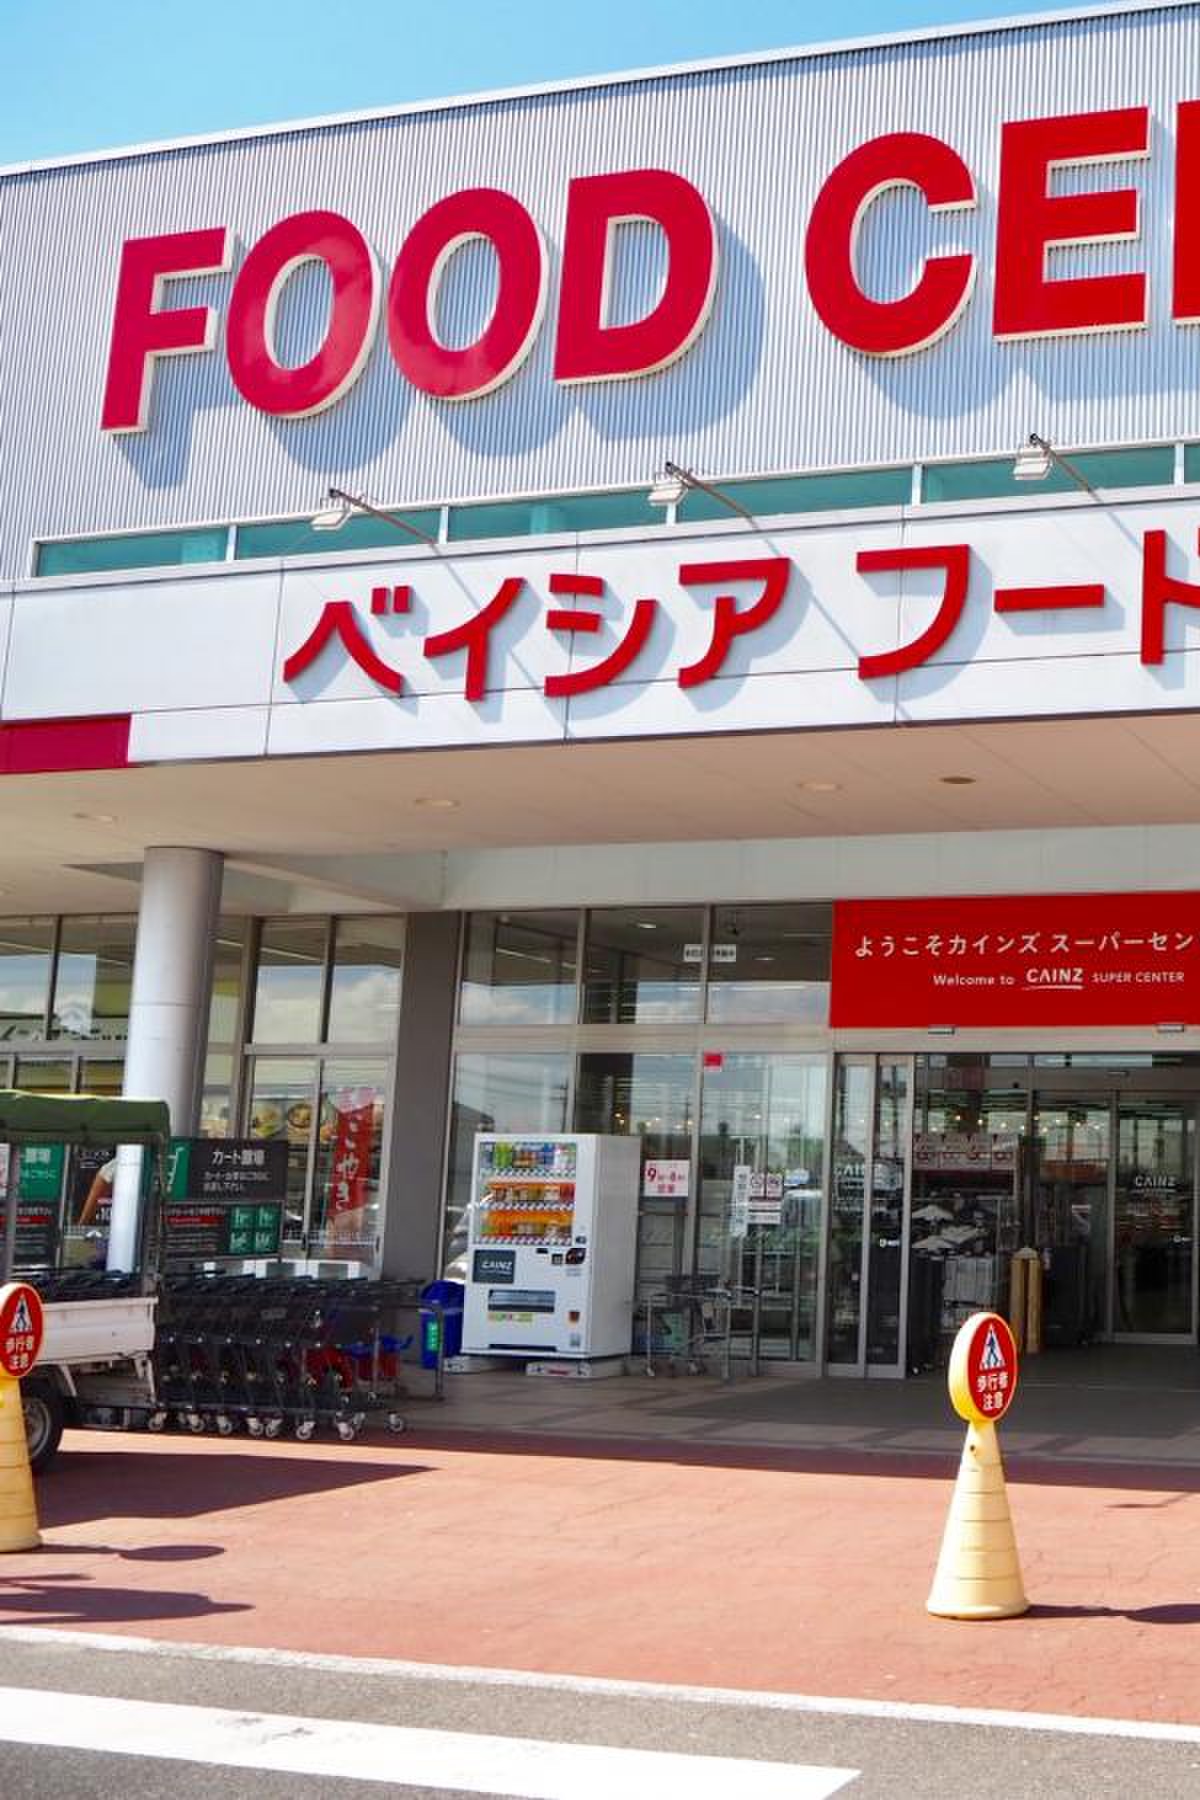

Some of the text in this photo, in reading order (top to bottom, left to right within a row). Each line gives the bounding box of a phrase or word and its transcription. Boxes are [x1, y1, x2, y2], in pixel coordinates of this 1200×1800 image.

[101, 169, 718, 434] FOOD
[283, 557, 791, 701] ベイシア
[855, 932, 1040, 957] ようこそカインズ
[933, 967, 1184, 986] Welcome to CAINZ SUPER CENTER
